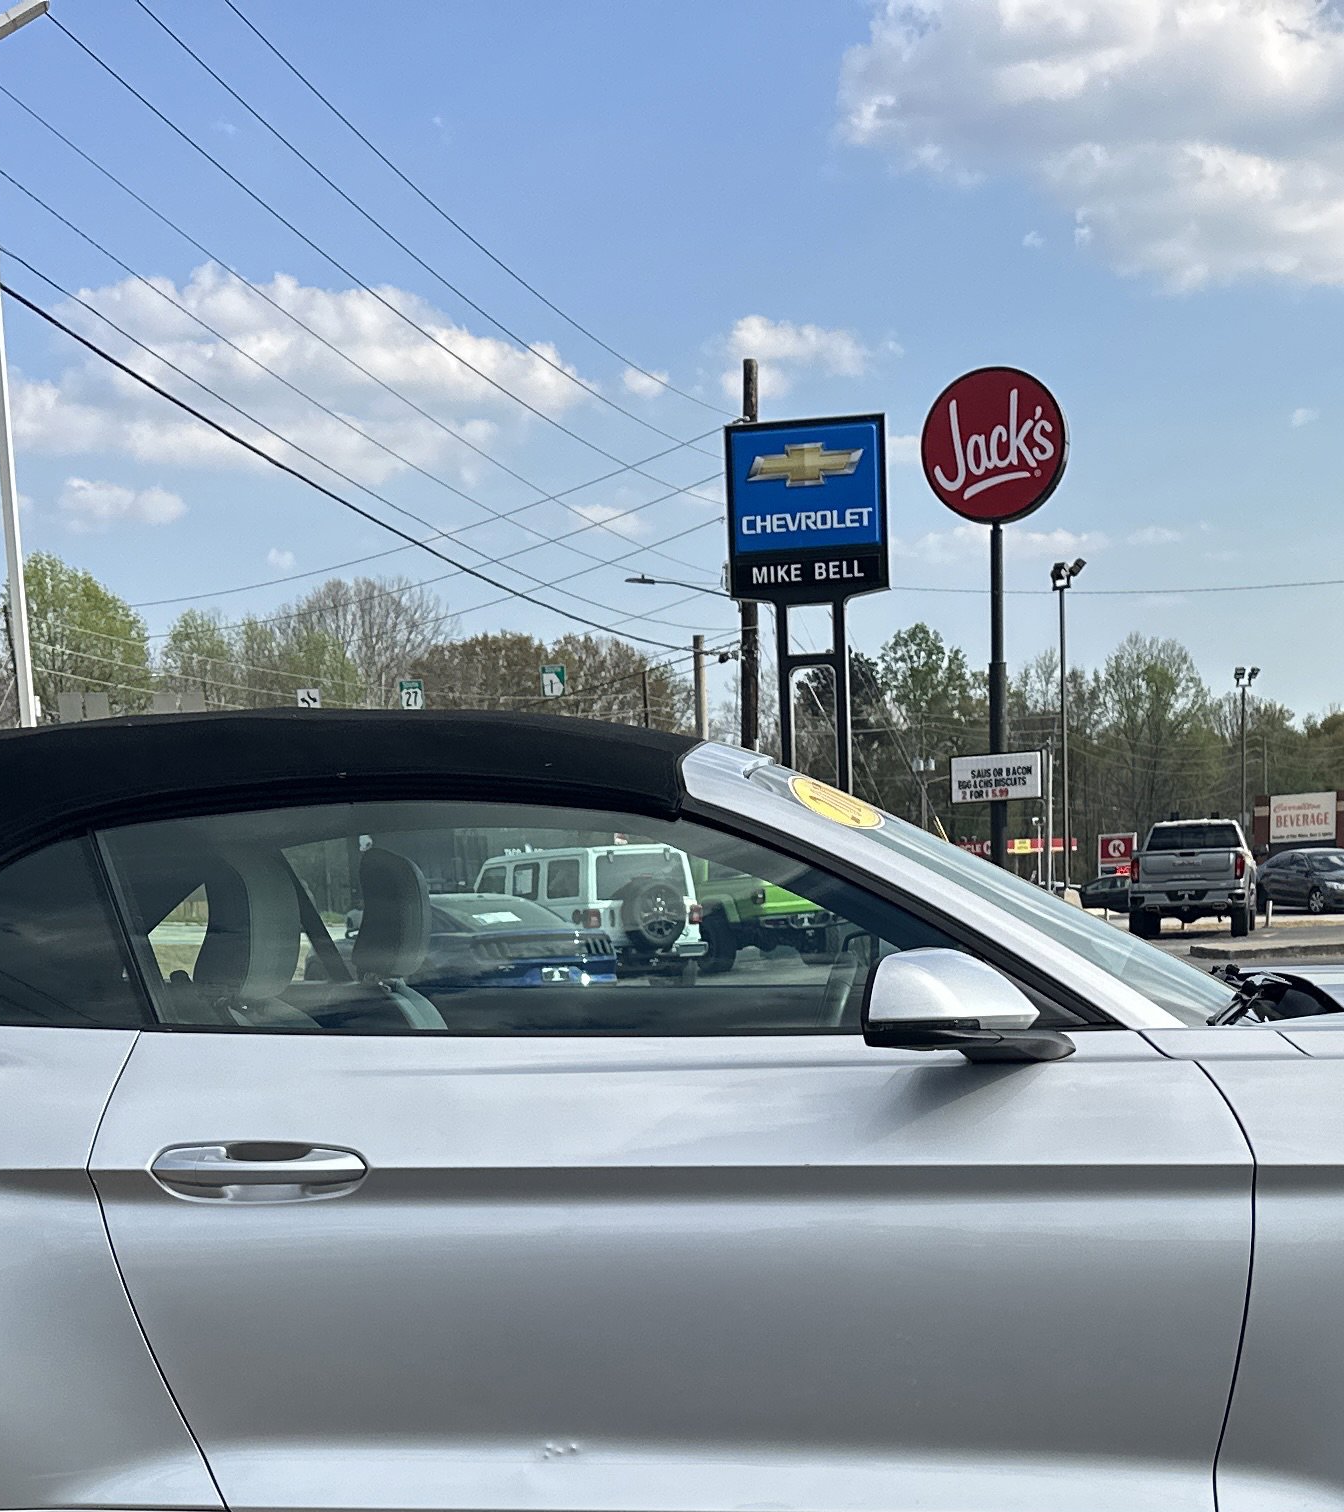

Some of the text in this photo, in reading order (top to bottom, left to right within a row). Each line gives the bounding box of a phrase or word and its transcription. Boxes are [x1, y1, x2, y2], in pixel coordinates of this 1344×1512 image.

[934, 388, 1054, 491] Jack's
[741, 507, 873, 535] CHEVROLET
[752, 560, 865, 584] MIKE BELL
[549, 679, 554, 694] 1
[405, 690, 418, 707] 27
[993, 767, 1003, 777] OR
[962, 790, 968, 800] 2
[970, 789, 984, 799] FOR
[1276, 812, 1330, 828] BEVERAGE
